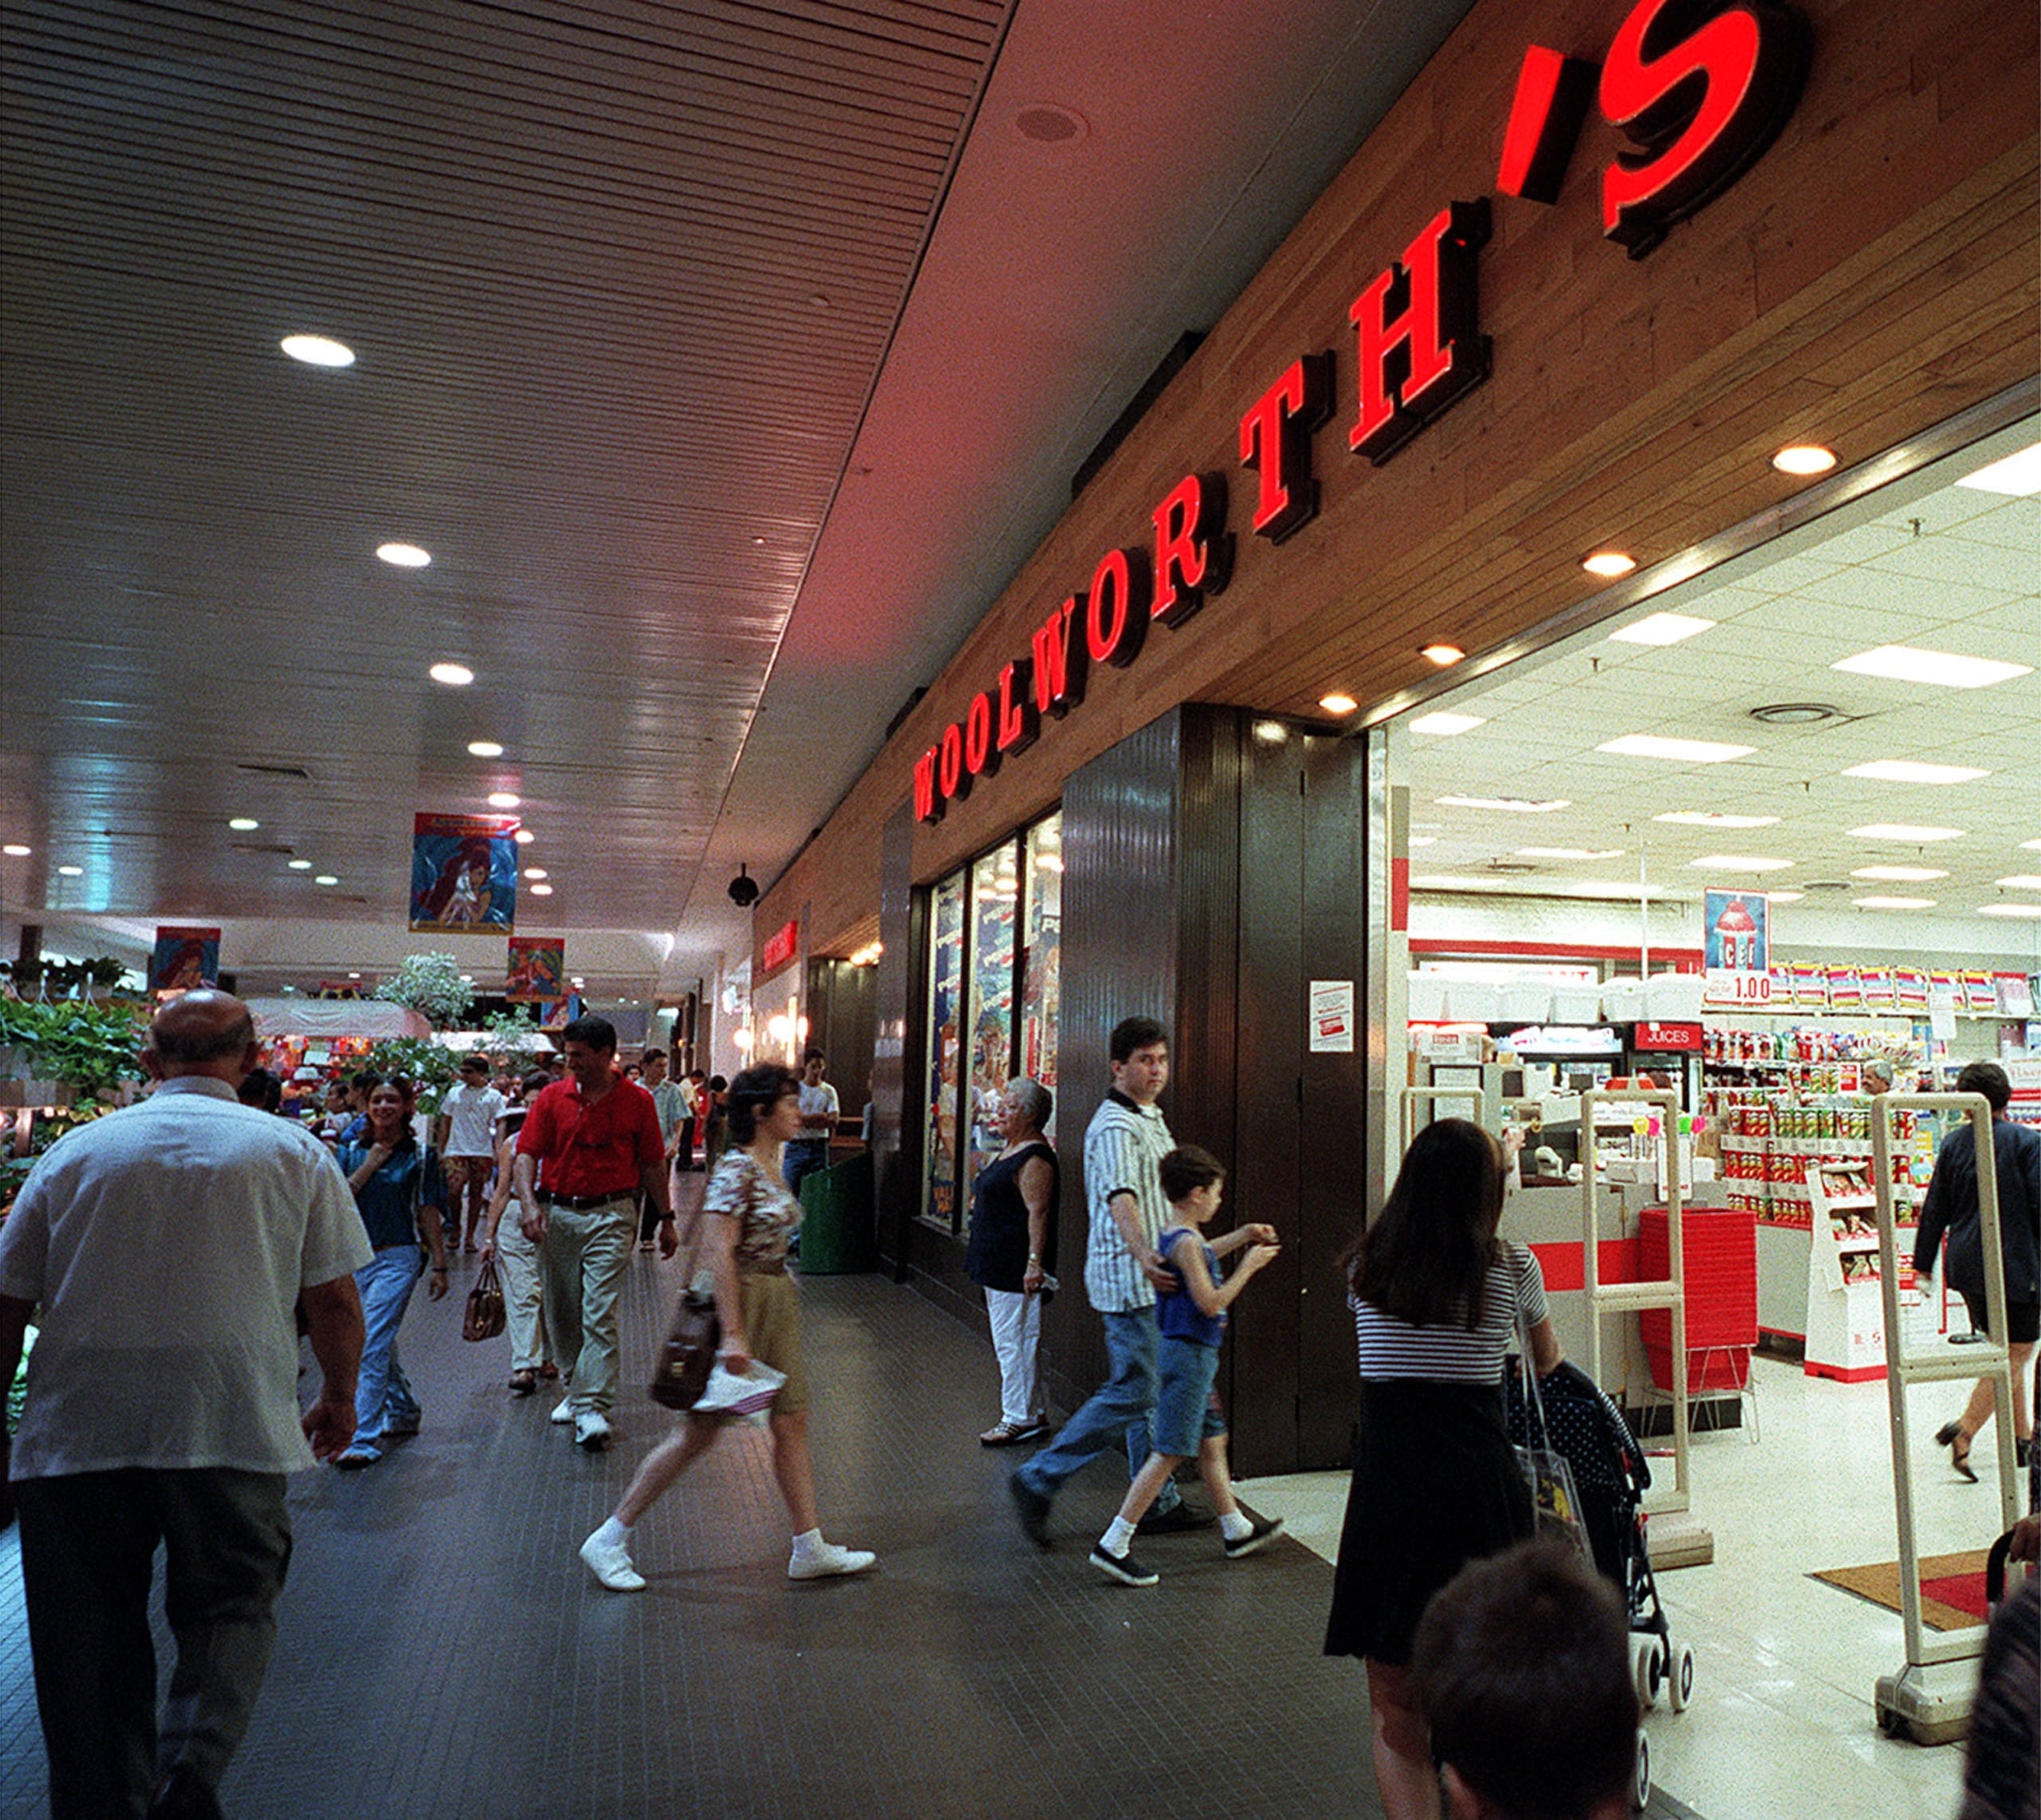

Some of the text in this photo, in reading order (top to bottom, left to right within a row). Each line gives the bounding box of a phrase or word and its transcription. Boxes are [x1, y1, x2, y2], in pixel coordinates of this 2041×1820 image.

[914, 0, 1760, 822] WOOLWORTH'S
[1735, 977, 1770, 999] 1.00
[1648, 1030, 1689, 1043] JUICES
